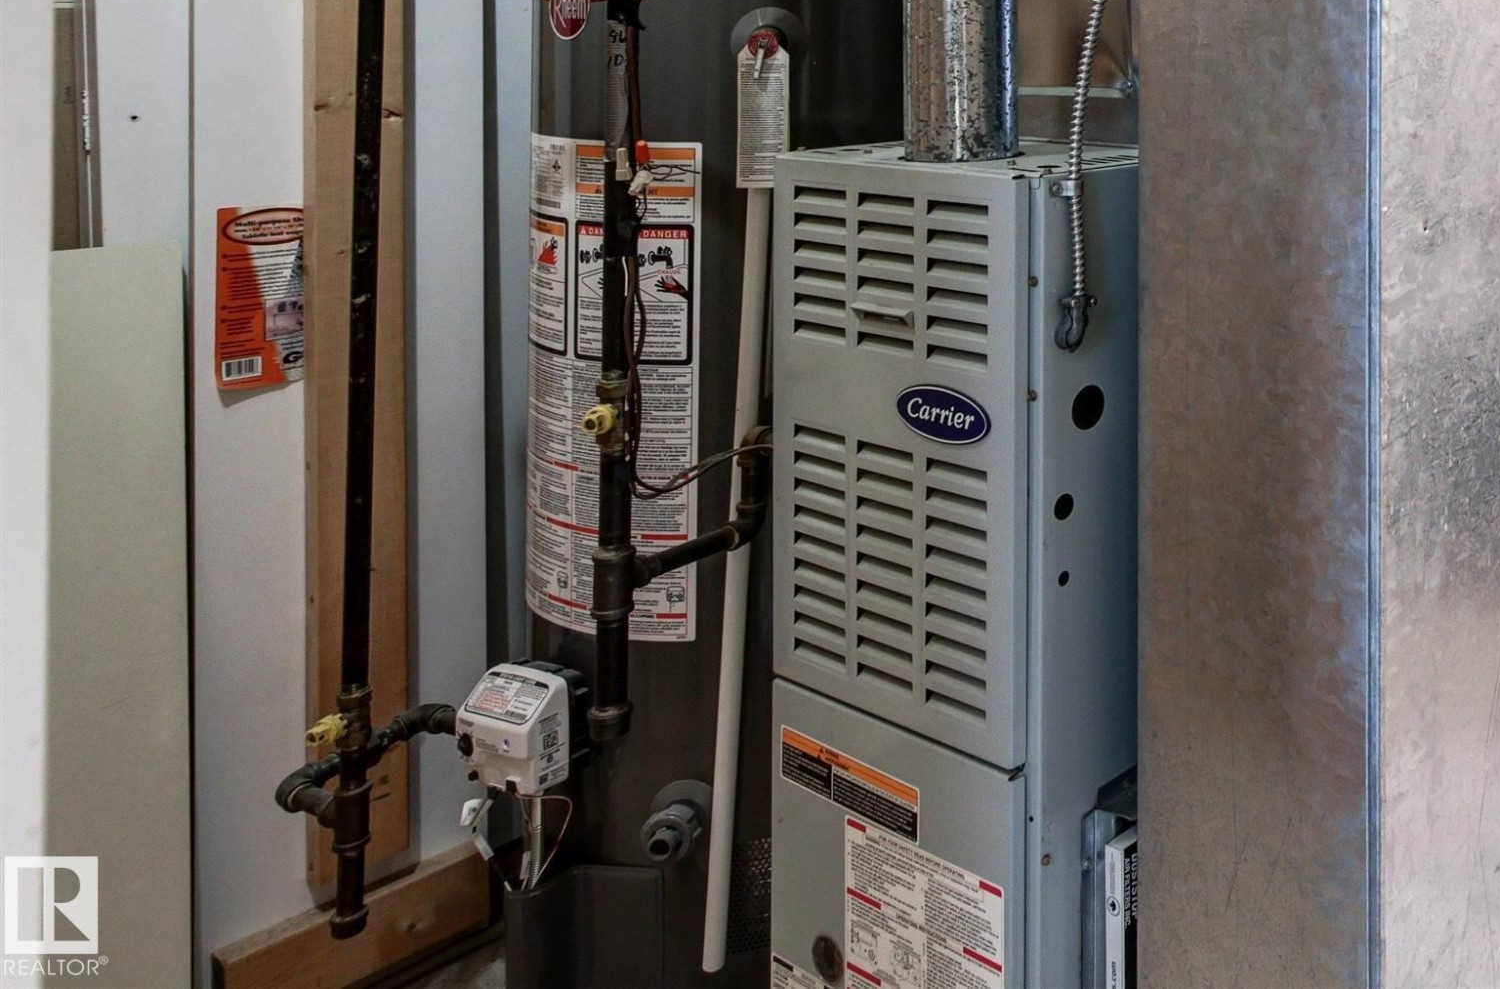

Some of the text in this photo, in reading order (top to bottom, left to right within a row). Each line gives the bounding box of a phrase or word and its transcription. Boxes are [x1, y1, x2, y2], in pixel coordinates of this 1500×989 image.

[642, 229, 689, 239] DANGER
[906, 397, 976, 431] Carrier
[1124, 874, 1132, 910] FILTERS
